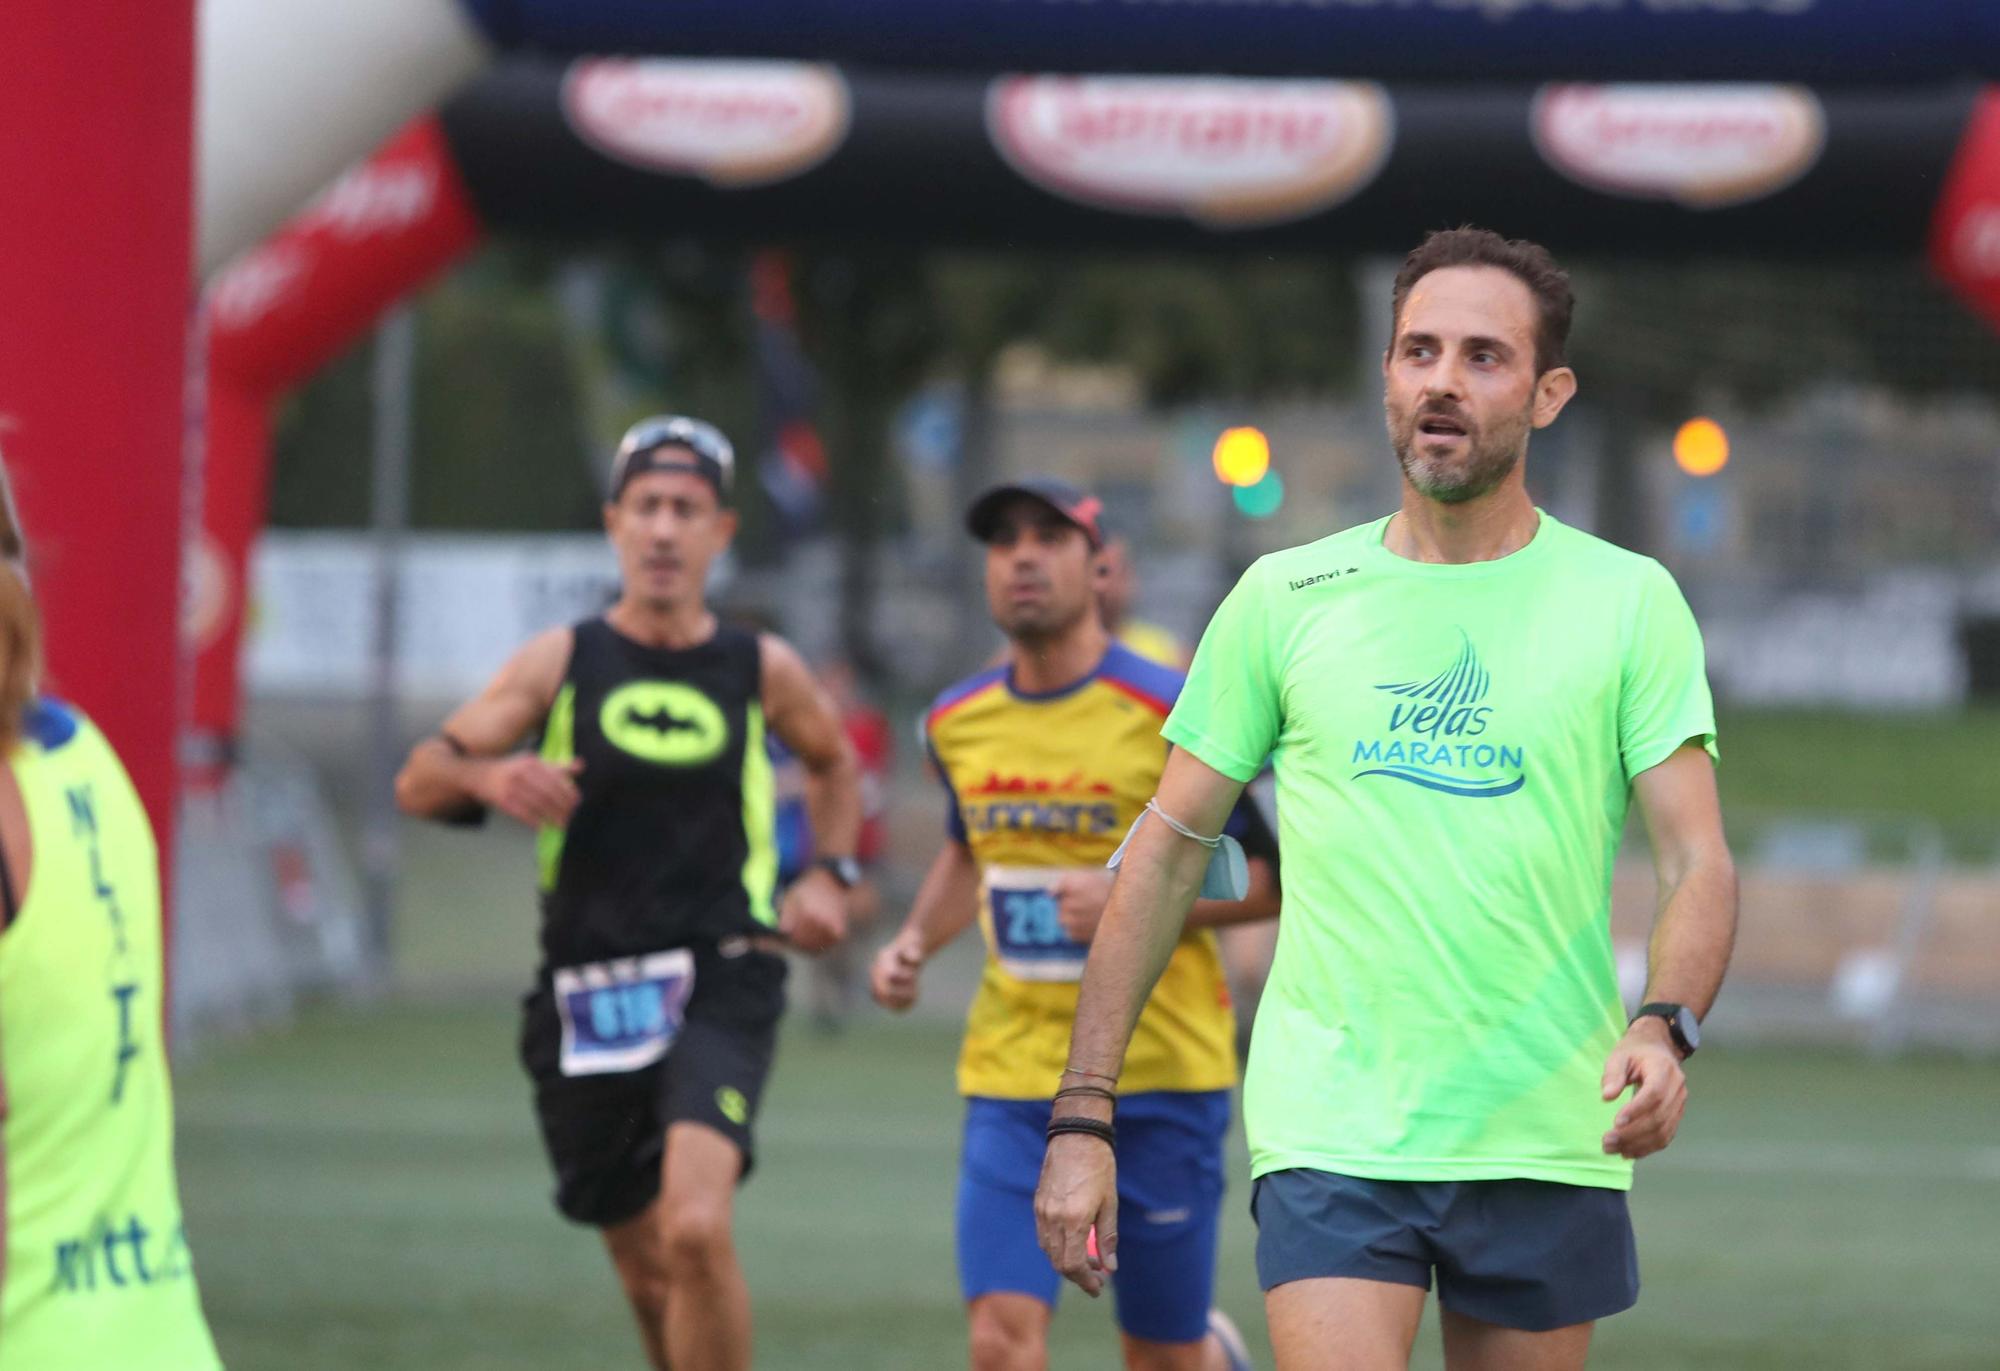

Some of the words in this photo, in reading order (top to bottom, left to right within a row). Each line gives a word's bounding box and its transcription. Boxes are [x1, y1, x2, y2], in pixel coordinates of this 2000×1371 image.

[1288, 569, 1341, 592] luanvi
[1389, 697, 1495, 741] velas
[1351, 740, 1525, 769] MARATON
